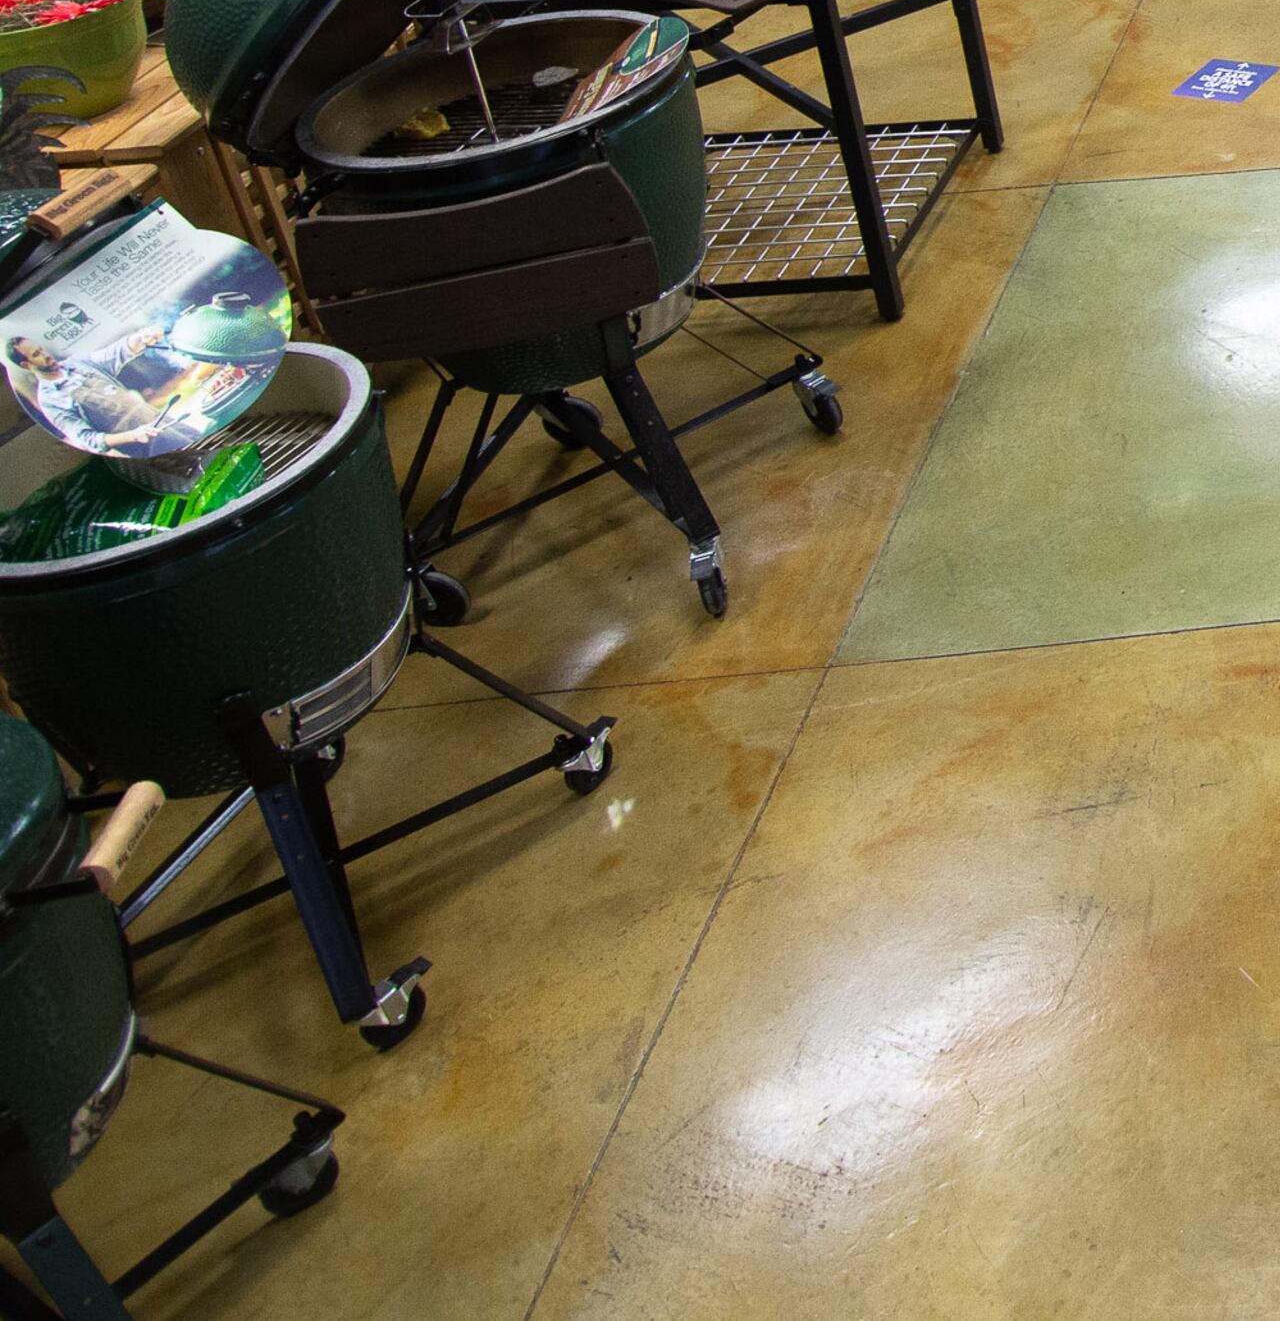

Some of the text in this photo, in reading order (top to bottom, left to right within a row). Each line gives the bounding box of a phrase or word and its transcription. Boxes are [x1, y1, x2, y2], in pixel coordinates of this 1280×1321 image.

[71, 218, 170, 289] Your Life Will Never
[80, 237, 162, 297] Taste the Same
[44, 320, 73, 341] Green
[46, 313, 65, 328] Big
[61, 328, 84, 342] Egg
